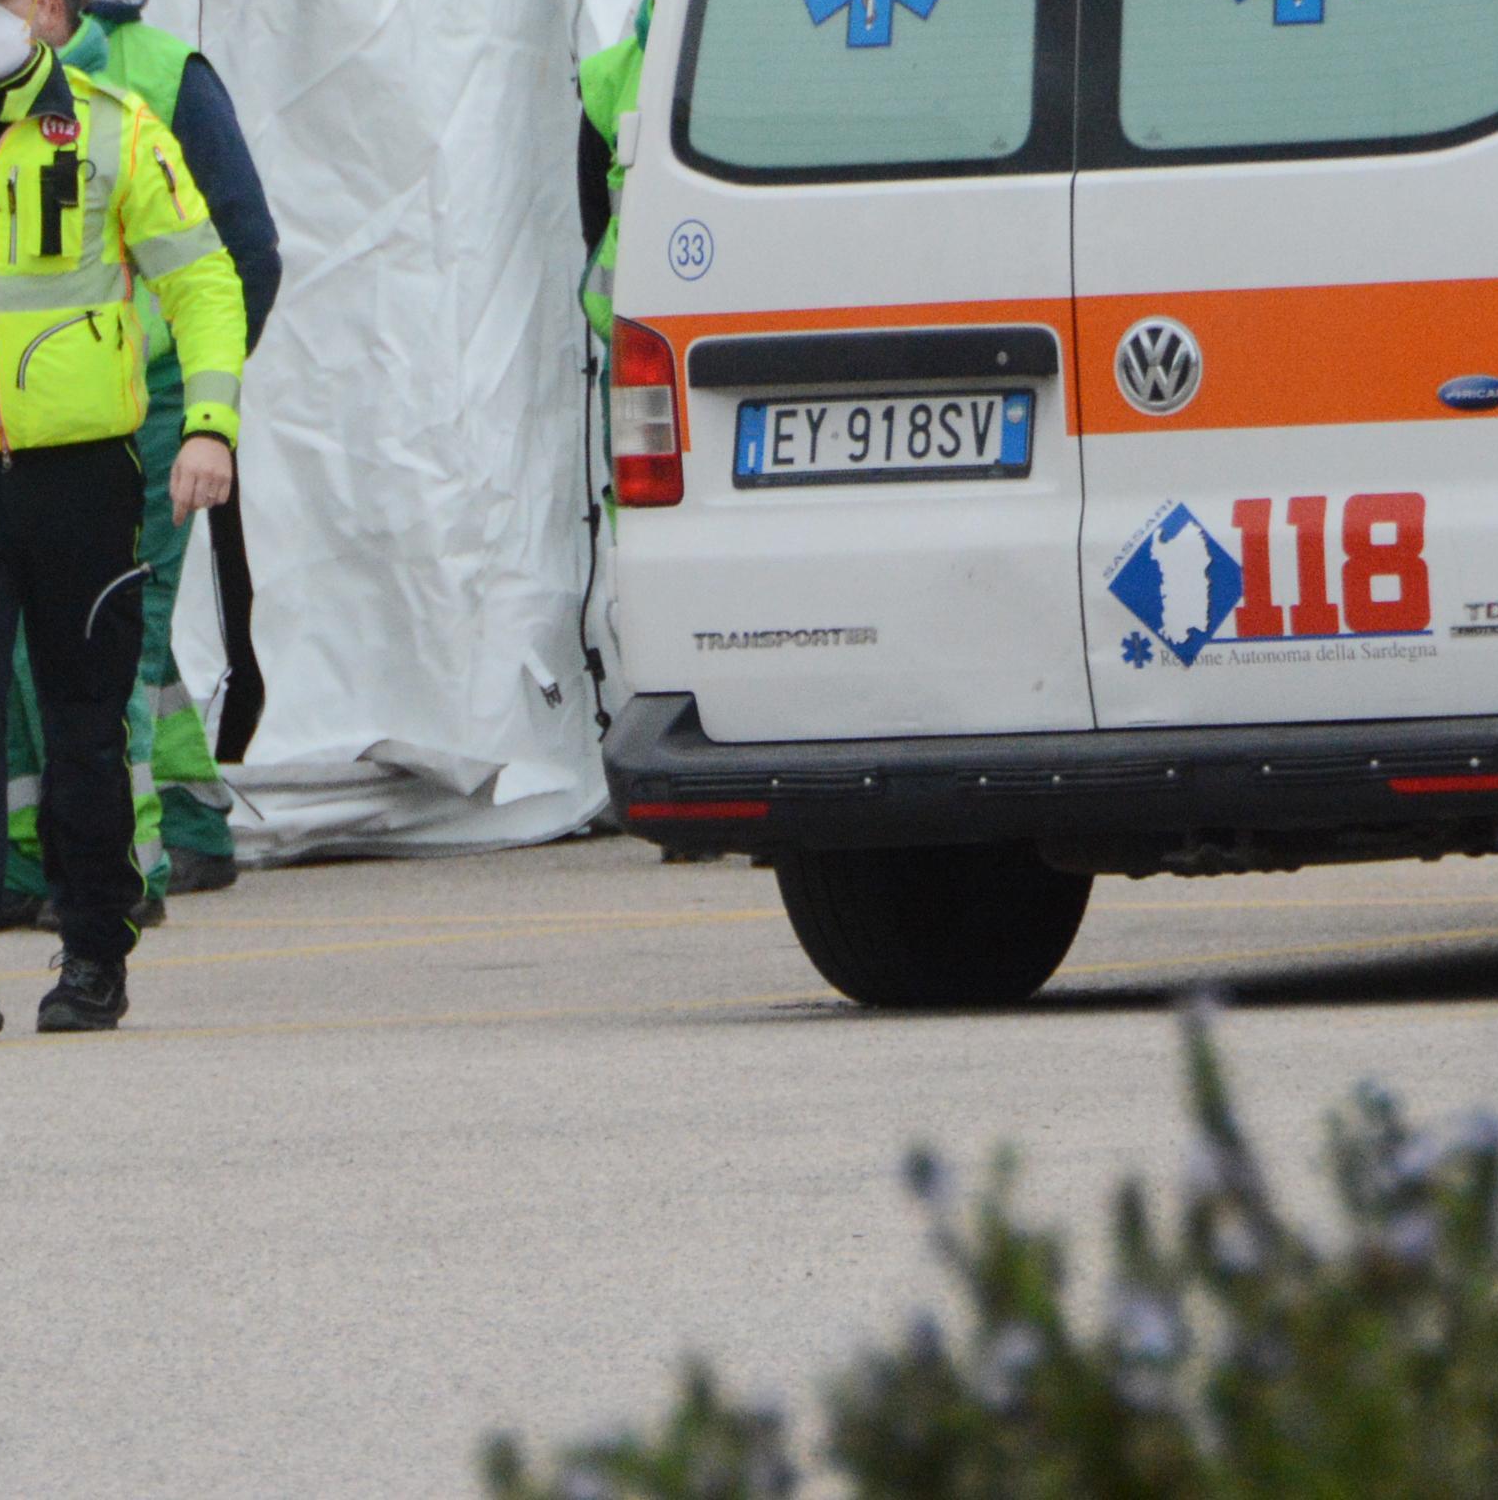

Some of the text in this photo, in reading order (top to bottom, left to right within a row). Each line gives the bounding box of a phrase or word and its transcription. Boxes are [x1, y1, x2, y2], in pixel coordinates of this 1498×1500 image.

[677, 234, 704, 267] 33
[772, 407, 827, 466] EY
[847, 400, 995, 463] 918SV
[1231, 491, 1431, 638] 118
[693, 626, 878, 651] TRANSPORTER
[1159, 641, 1438, 670] Reone Autonoma della Sardegna
